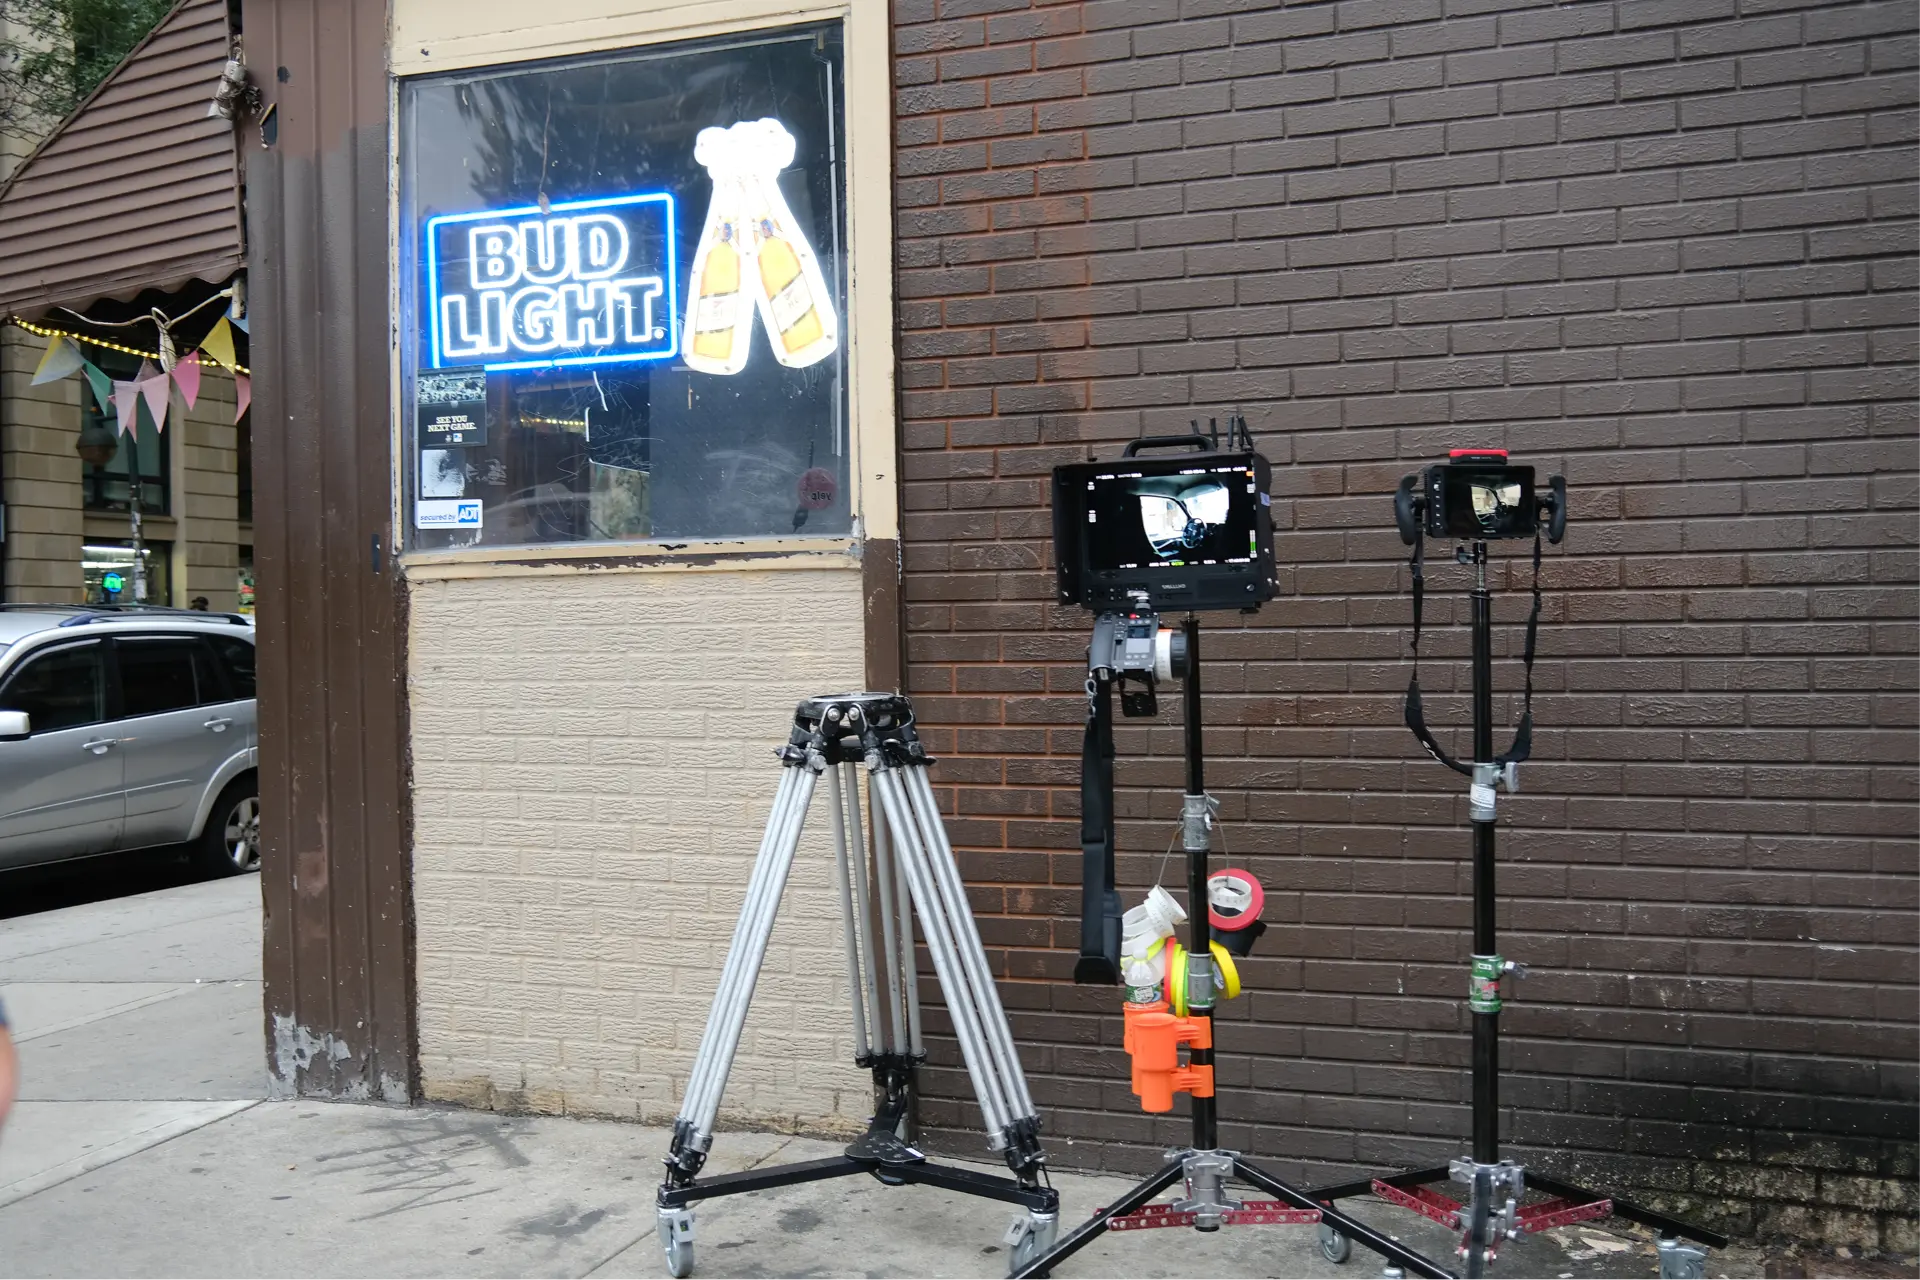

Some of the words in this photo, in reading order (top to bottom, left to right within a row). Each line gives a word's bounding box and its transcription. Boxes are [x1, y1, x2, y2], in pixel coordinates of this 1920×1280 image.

[468, 214, 629, 290] BUD
[436, 416, 451, 424] SEE
[451, 415, 468, 423] YOU
[427, 424, 450, 432] NEXT
[448, 513, 457, 522] by
[459, 506, 479, 520] ADT
